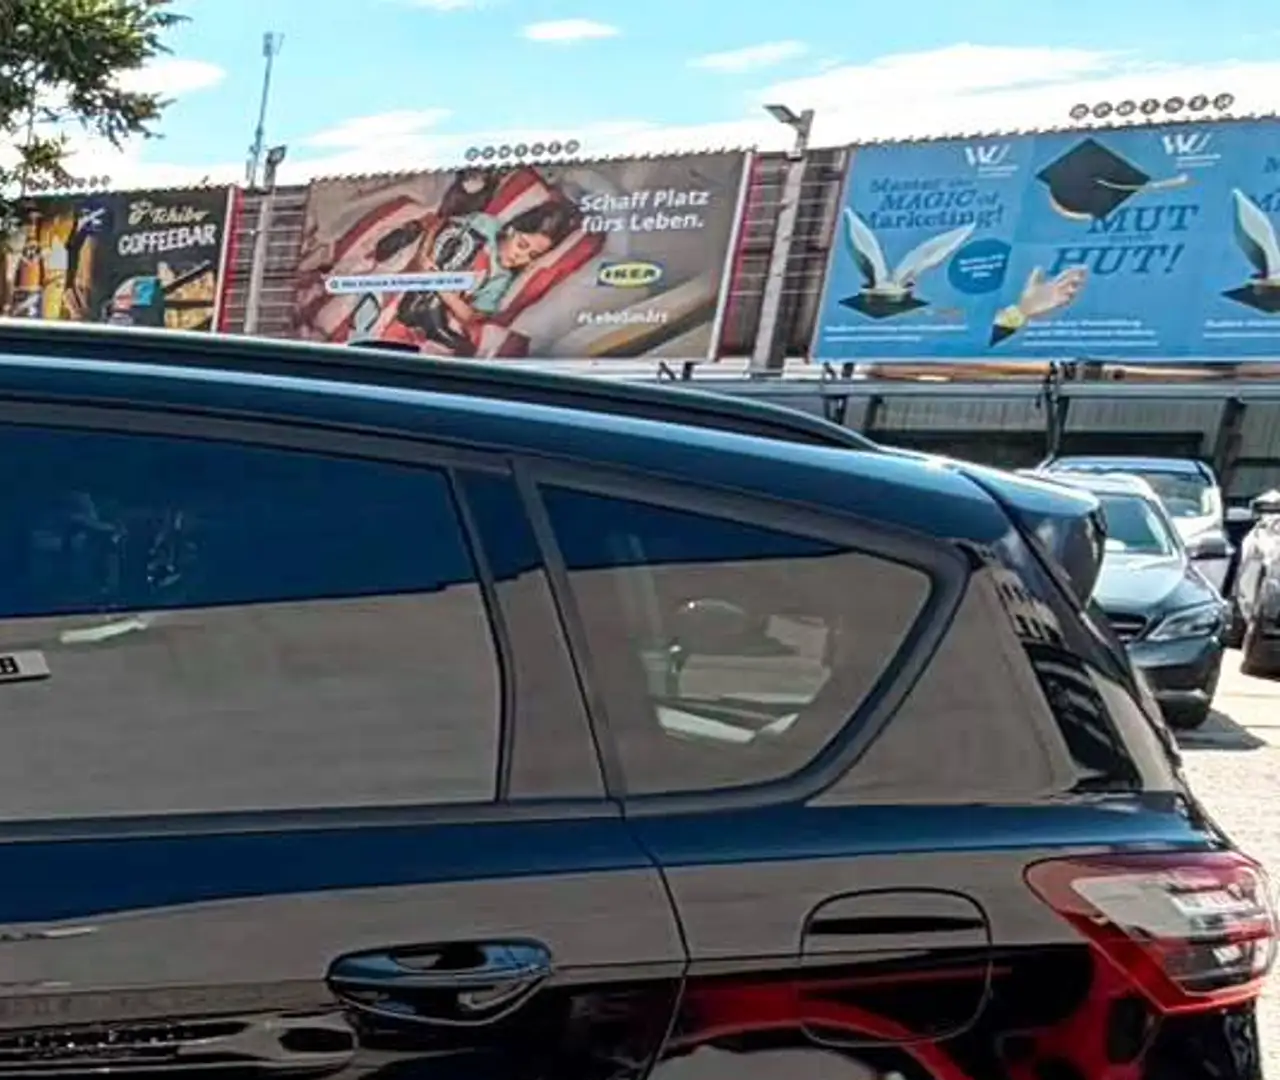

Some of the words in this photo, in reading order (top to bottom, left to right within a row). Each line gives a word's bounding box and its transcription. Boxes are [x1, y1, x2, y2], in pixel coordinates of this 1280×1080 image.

[580, 191, 649, 212] Schaff
[653, 188, 711, 207] Platz
[880, 190, 977, 211] MAGIC
[581, 215, 622, 233] fürs
[630, 211, 704, 231] Leben.
[1088, 204, 1200, 234] MUT
[118, 223, 217, 256] COFFEEBAR
[1047, 244, 1185, 276] HUT!
